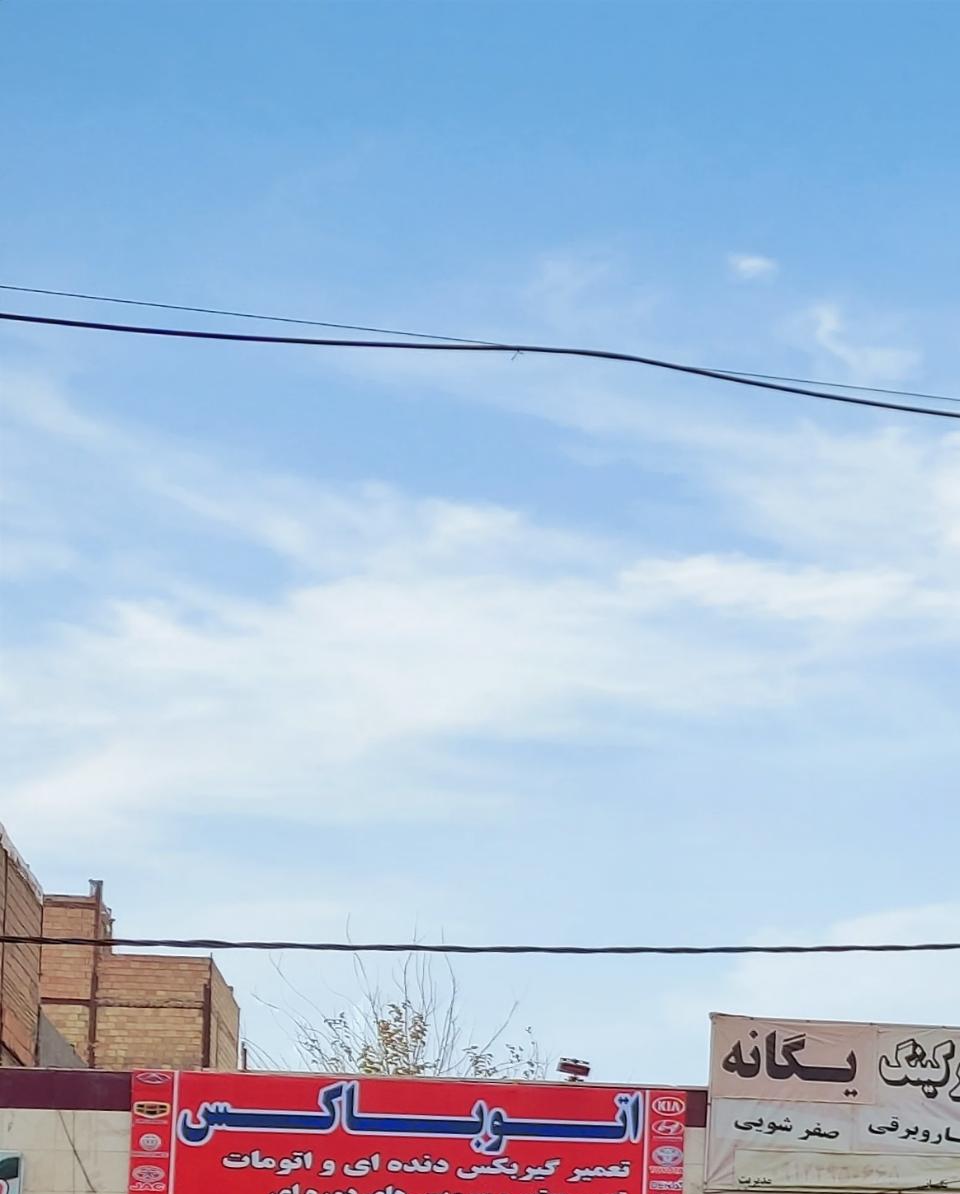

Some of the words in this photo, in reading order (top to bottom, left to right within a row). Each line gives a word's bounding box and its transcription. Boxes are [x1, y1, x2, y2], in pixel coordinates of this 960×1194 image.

[721, 1029, 858, 1097] یگانه
[656, 1099, 681, 1113] KIA
[799, 1121, 840, 1141] صفر
[222, 1150, 313, 1176] اتومات
[318, 1158, 337, 1177] و
[343, 1153, 381, 1177] ای
[386, 1155, 450, 1176] دنده
[566, 1160, 631, 1183] تعمیر
[129, 1182, 167, 1192] JAC
